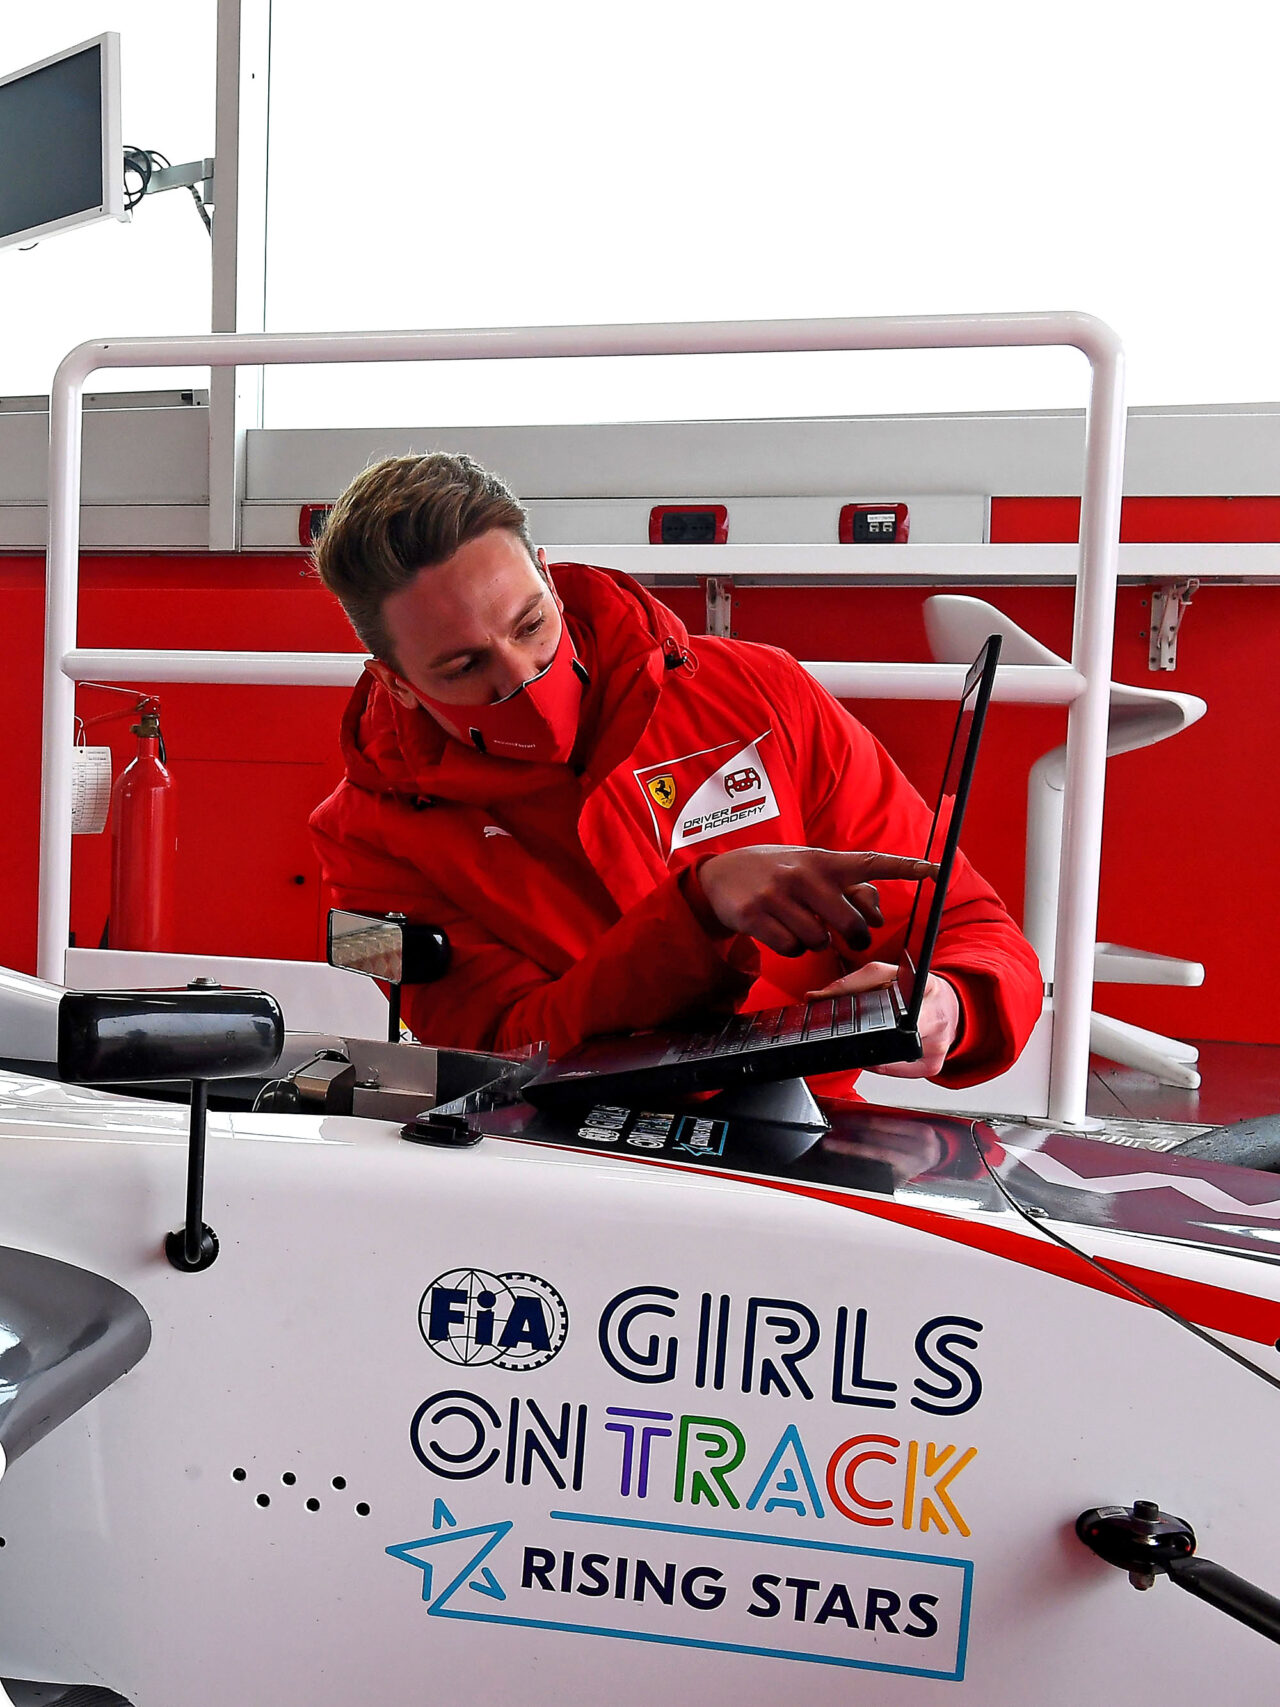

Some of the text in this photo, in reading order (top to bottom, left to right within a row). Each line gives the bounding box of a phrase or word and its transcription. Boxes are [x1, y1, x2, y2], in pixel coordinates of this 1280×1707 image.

[683, 806, 730, 829] DRIVER
[703, 804, 766, 831] ACADEMY
[598, 1285, 984, 1417] GIRLS
[409, 1389, 978, 1537] ON TRACK
[520, 1546, 941, 1638] RISING STARS
